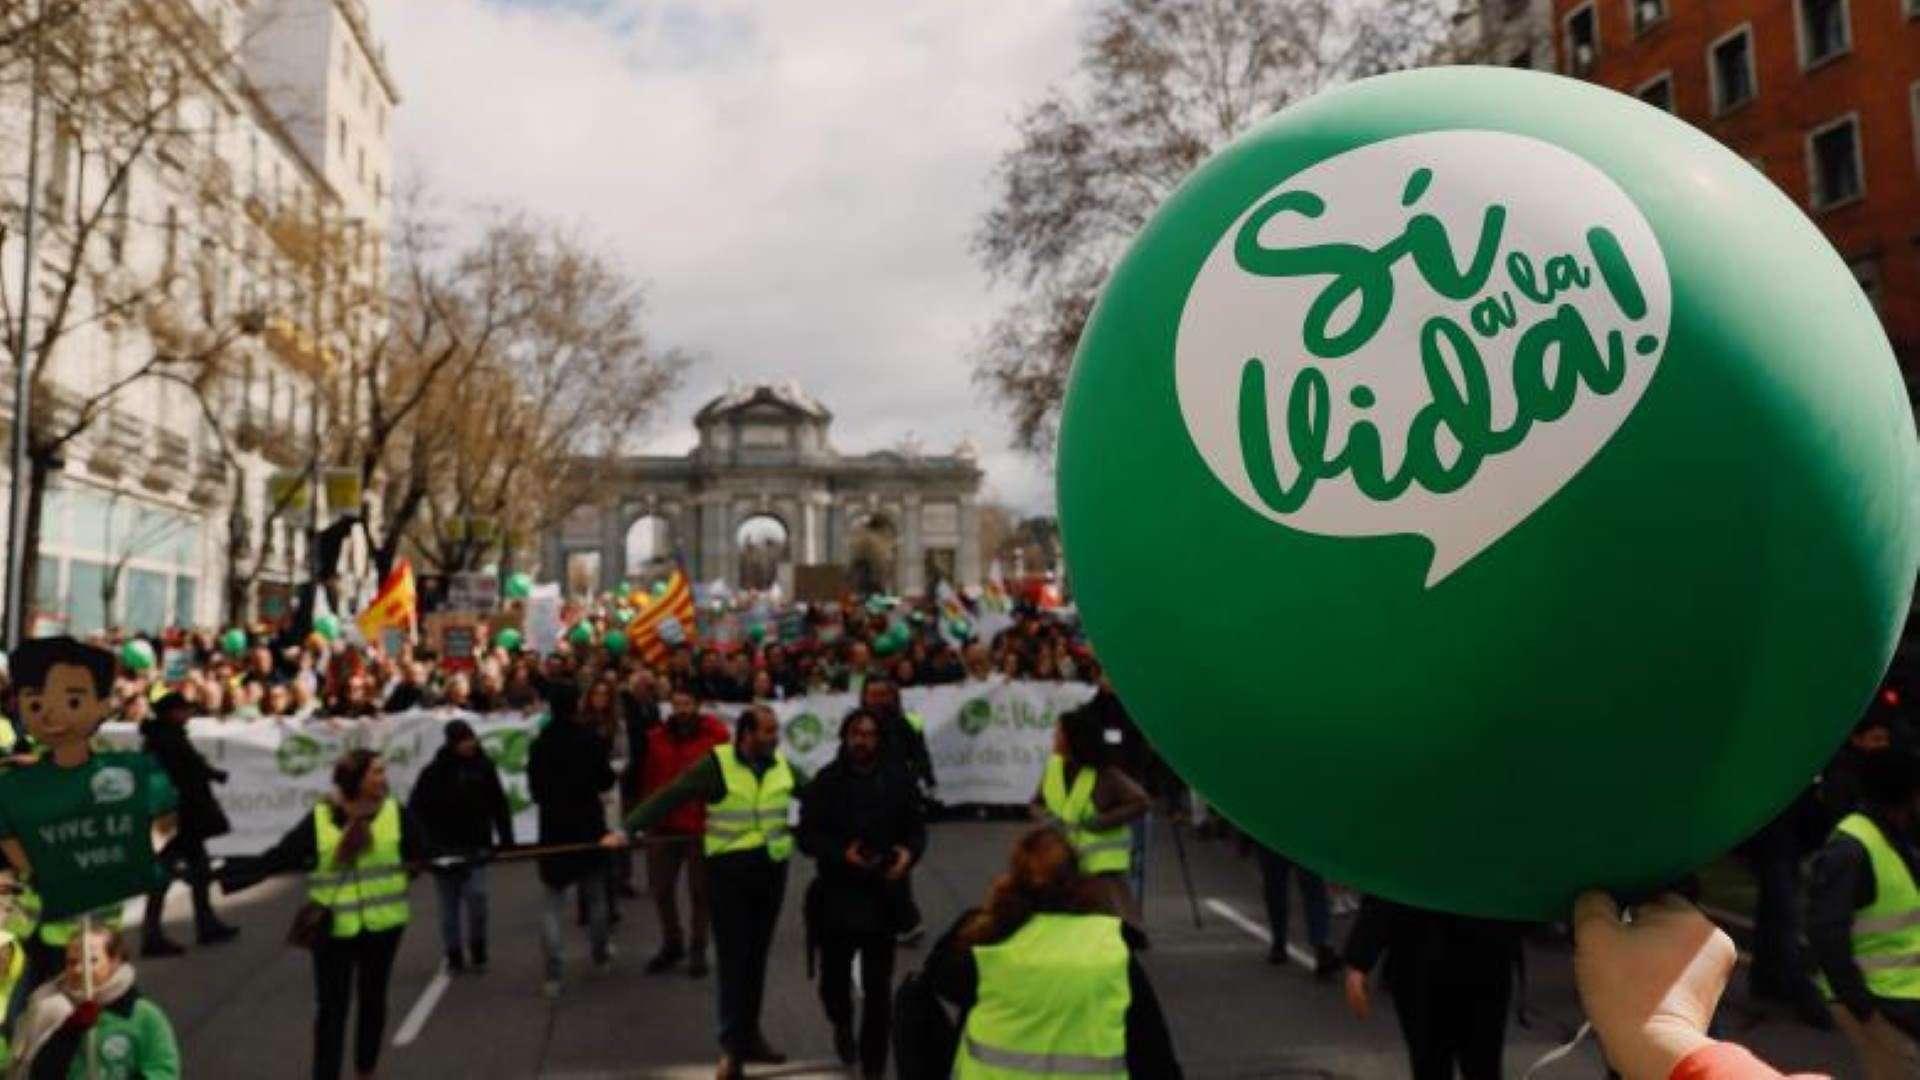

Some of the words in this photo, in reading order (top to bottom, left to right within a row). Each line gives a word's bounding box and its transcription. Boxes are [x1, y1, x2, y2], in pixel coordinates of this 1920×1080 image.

[1234, 167, 1506, 358] Sí
[1471, 290, 1516, 339] a
[1506, 250, 1590, 306] la
